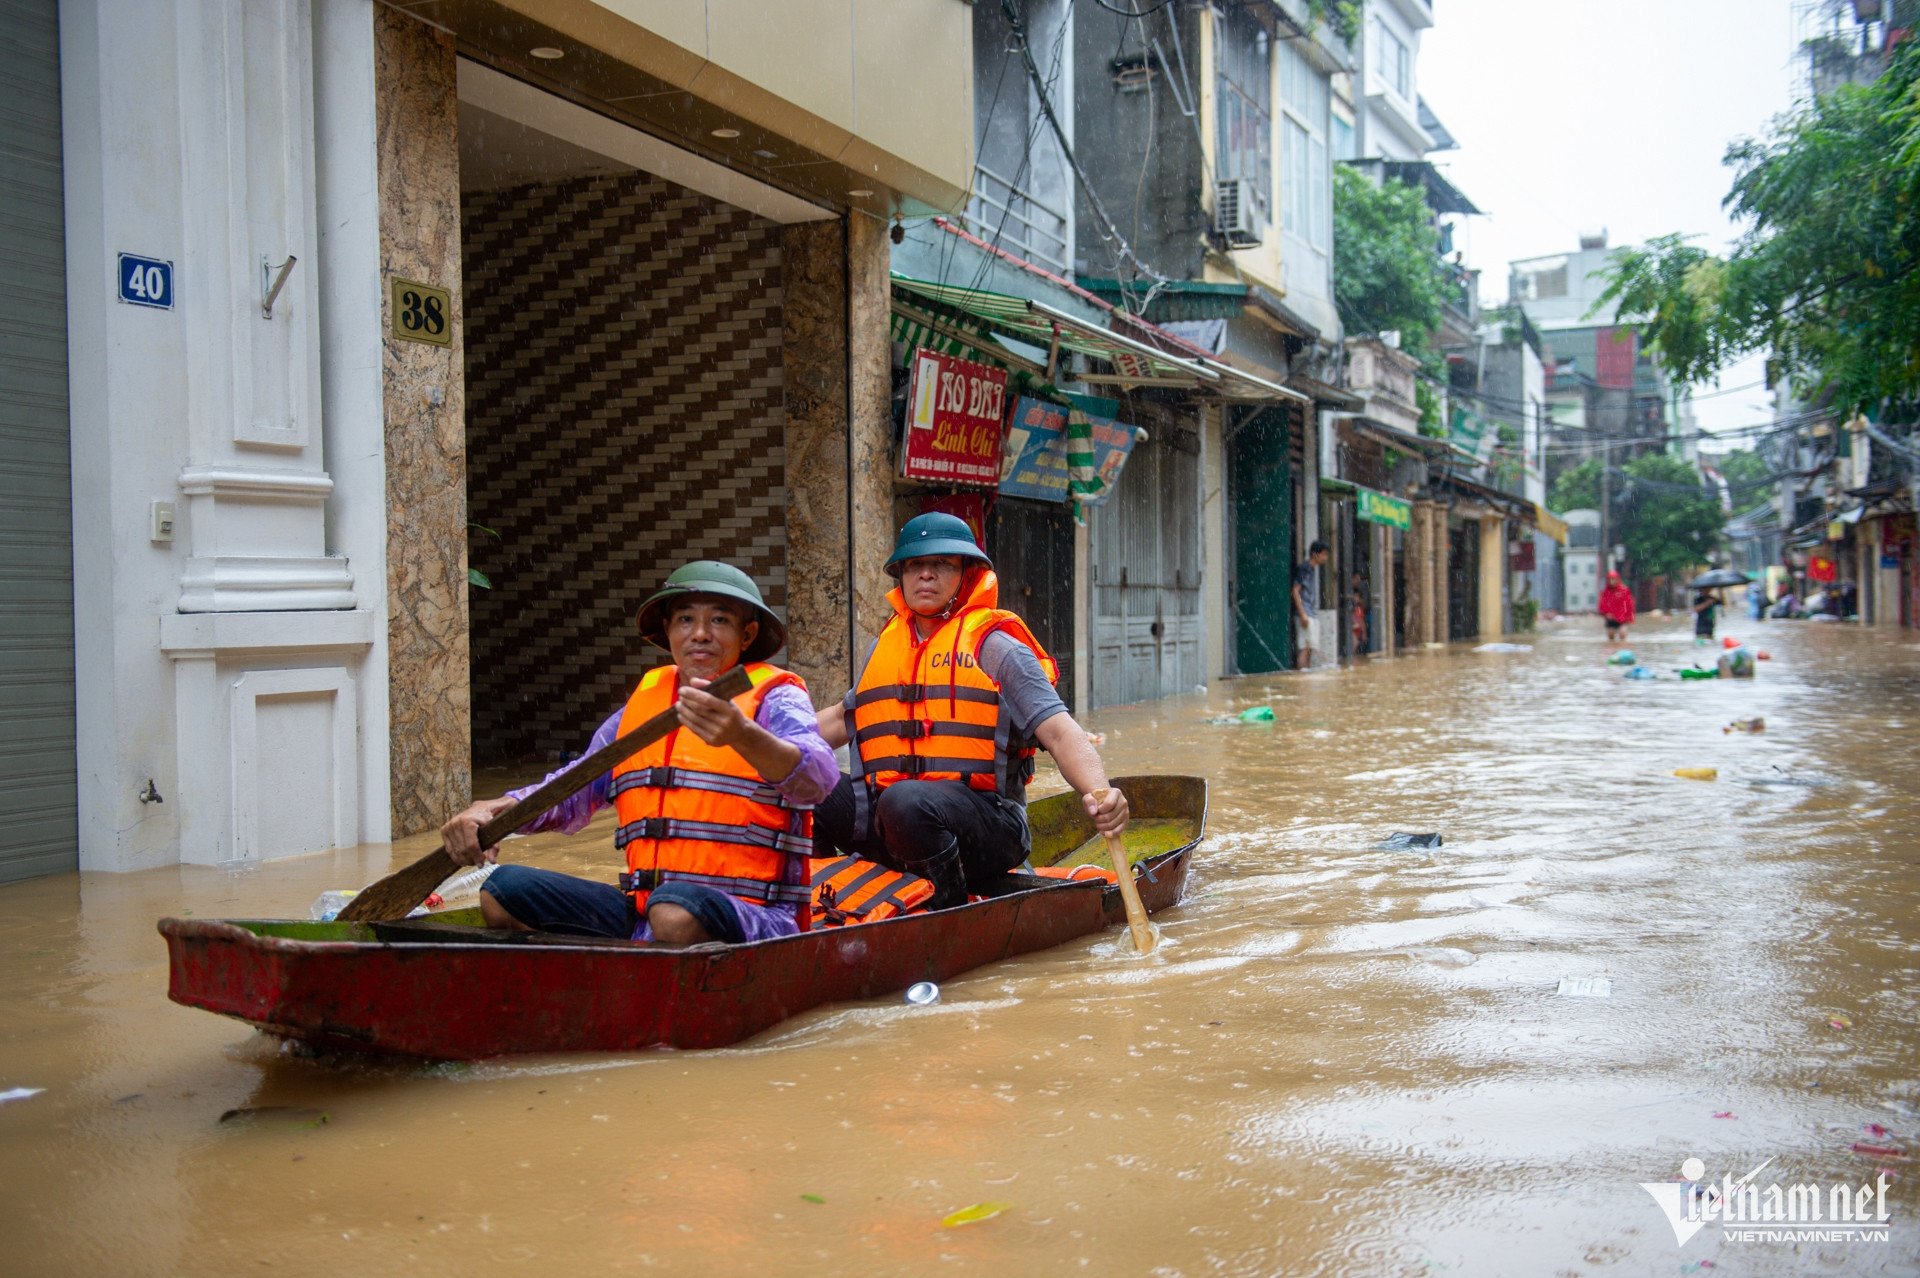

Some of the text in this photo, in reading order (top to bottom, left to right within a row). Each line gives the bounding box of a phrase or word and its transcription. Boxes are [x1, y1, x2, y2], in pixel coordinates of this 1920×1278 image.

[128, 264, 164, 300] 40
[402, 291, 444, 335] 38
[938, 361, 966, 413] ÁO
[931, 420, 996, 457] Linh Chi
[931, 651, 974, 668] CAND
